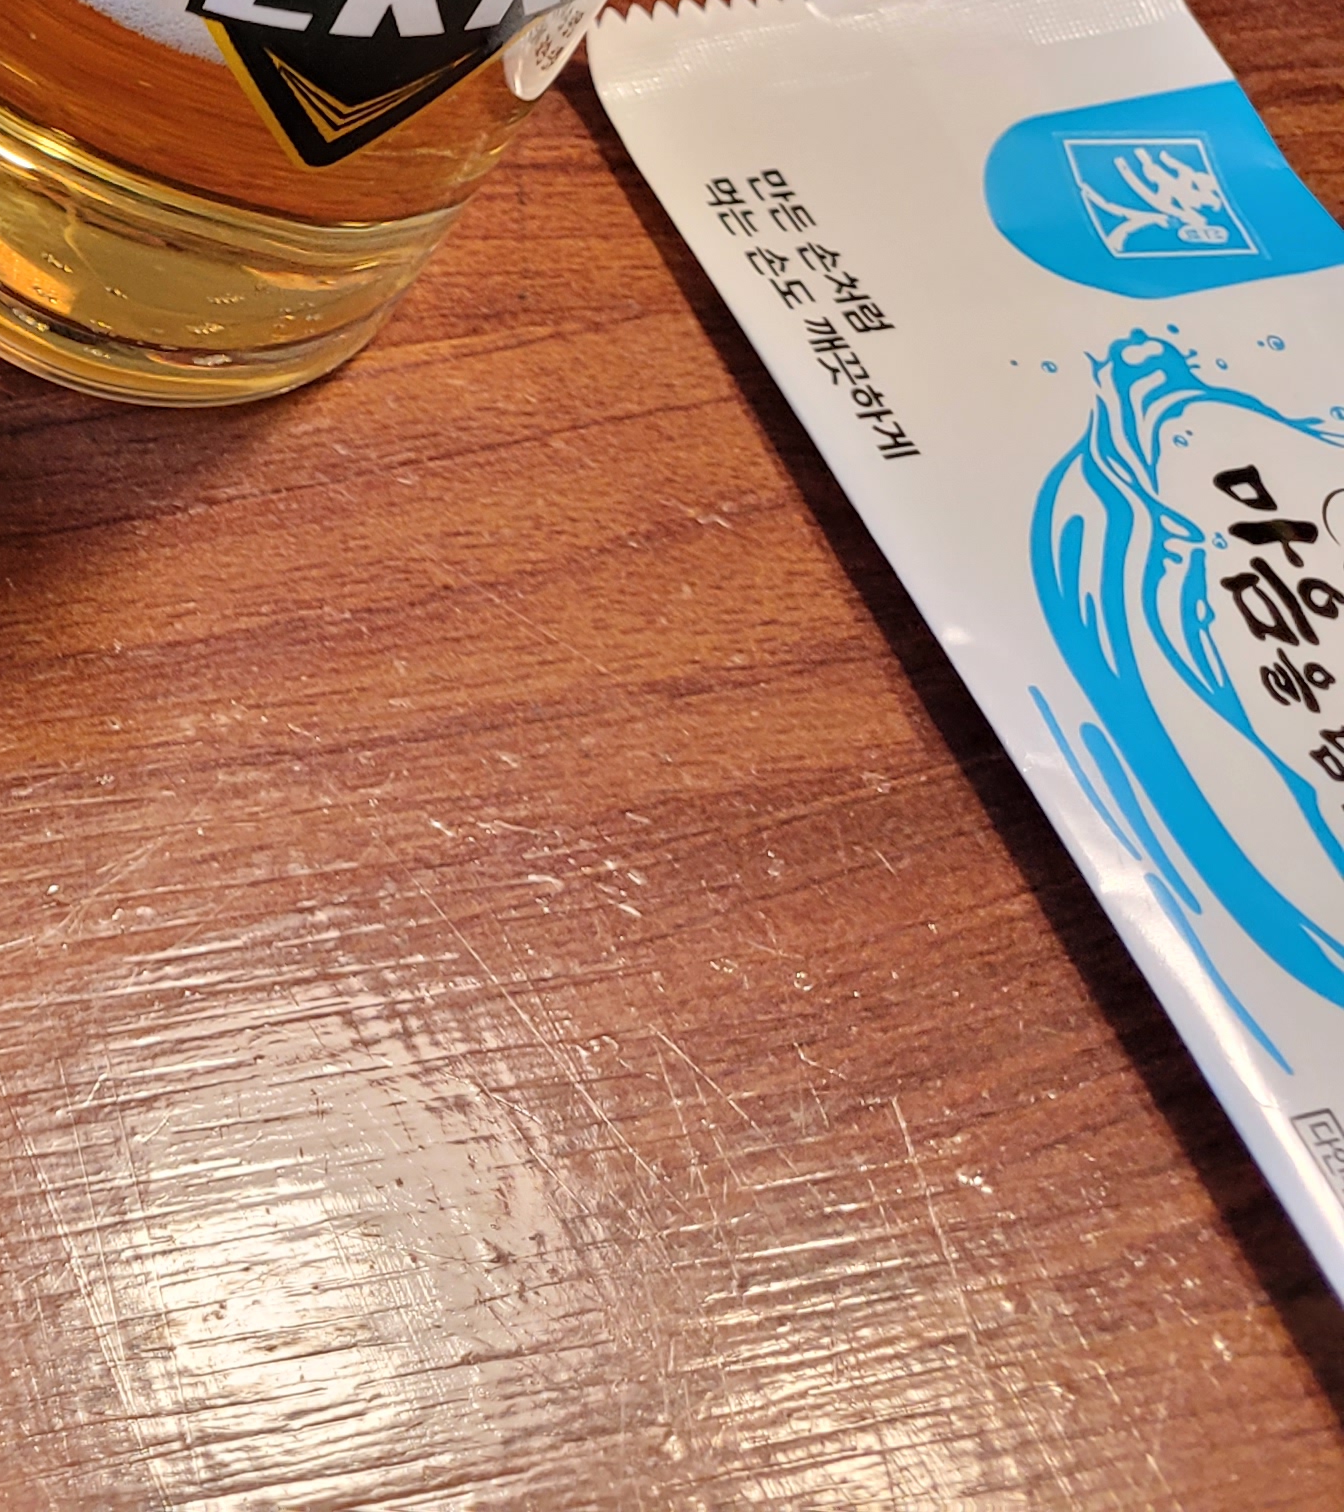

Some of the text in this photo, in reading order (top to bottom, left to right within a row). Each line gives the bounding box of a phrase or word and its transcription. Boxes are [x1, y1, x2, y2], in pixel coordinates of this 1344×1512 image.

[705, 177, 922, 461] 먹는 손도 깨끗하게
[746, 168, 896, 334] 만든 손처럼
[1213, 464, 1344, 714] 마음을
